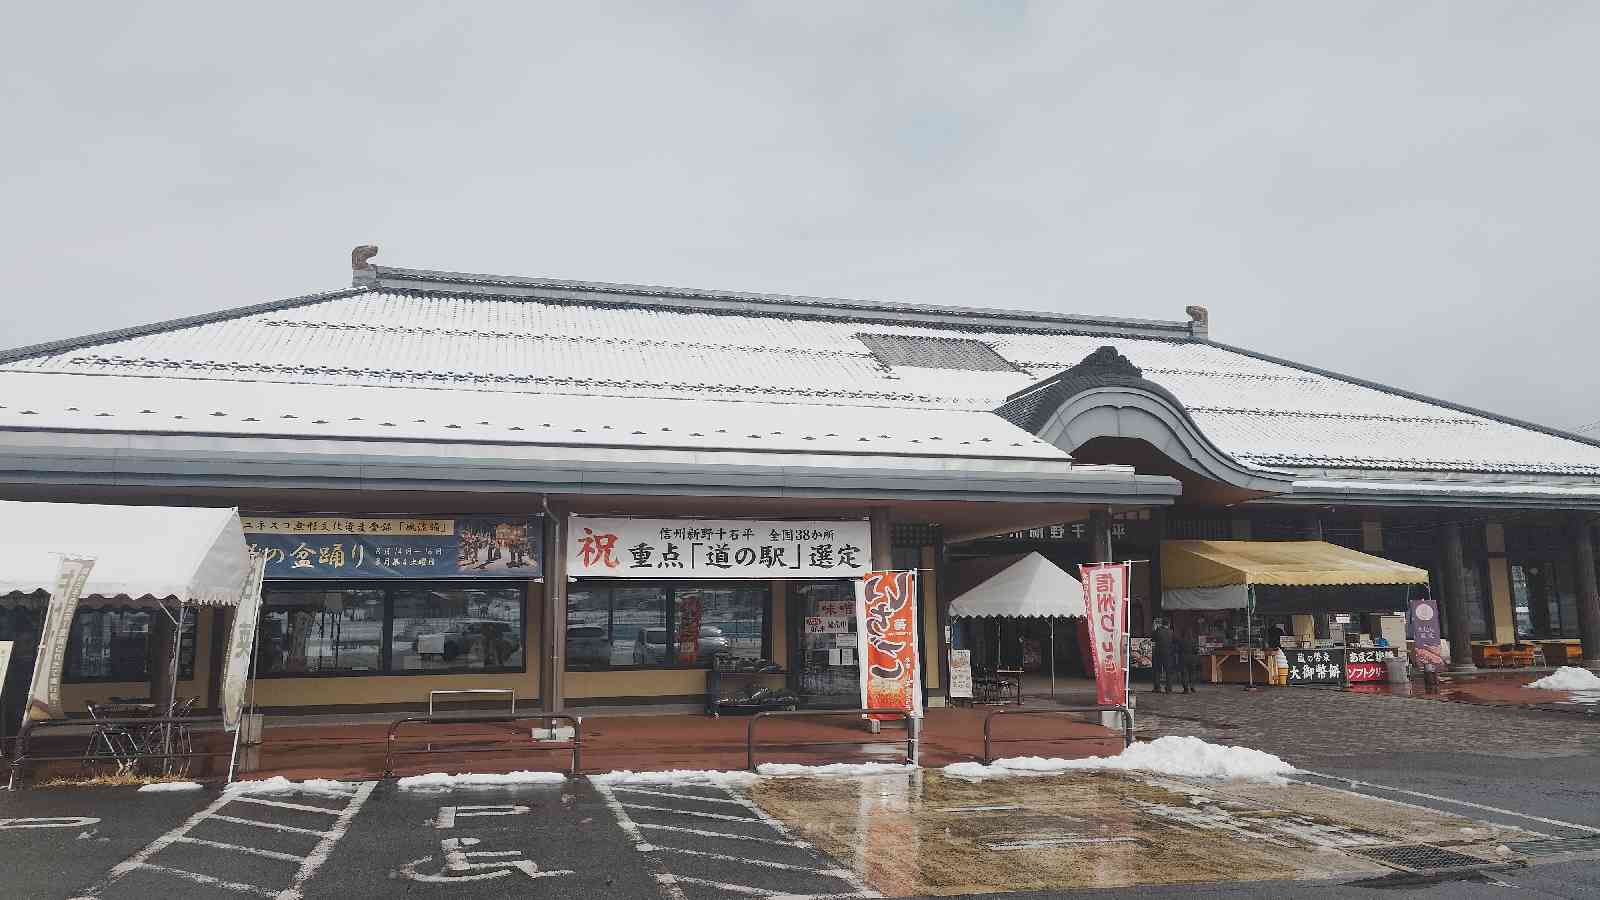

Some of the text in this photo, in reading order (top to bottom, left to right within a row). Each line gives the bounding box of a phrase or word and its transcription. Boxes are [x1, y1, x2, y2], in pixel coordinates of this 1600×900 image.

[576, 527, 620, 568] 祝
[627, 542, 863, 569] 重点「道の駅」選定
